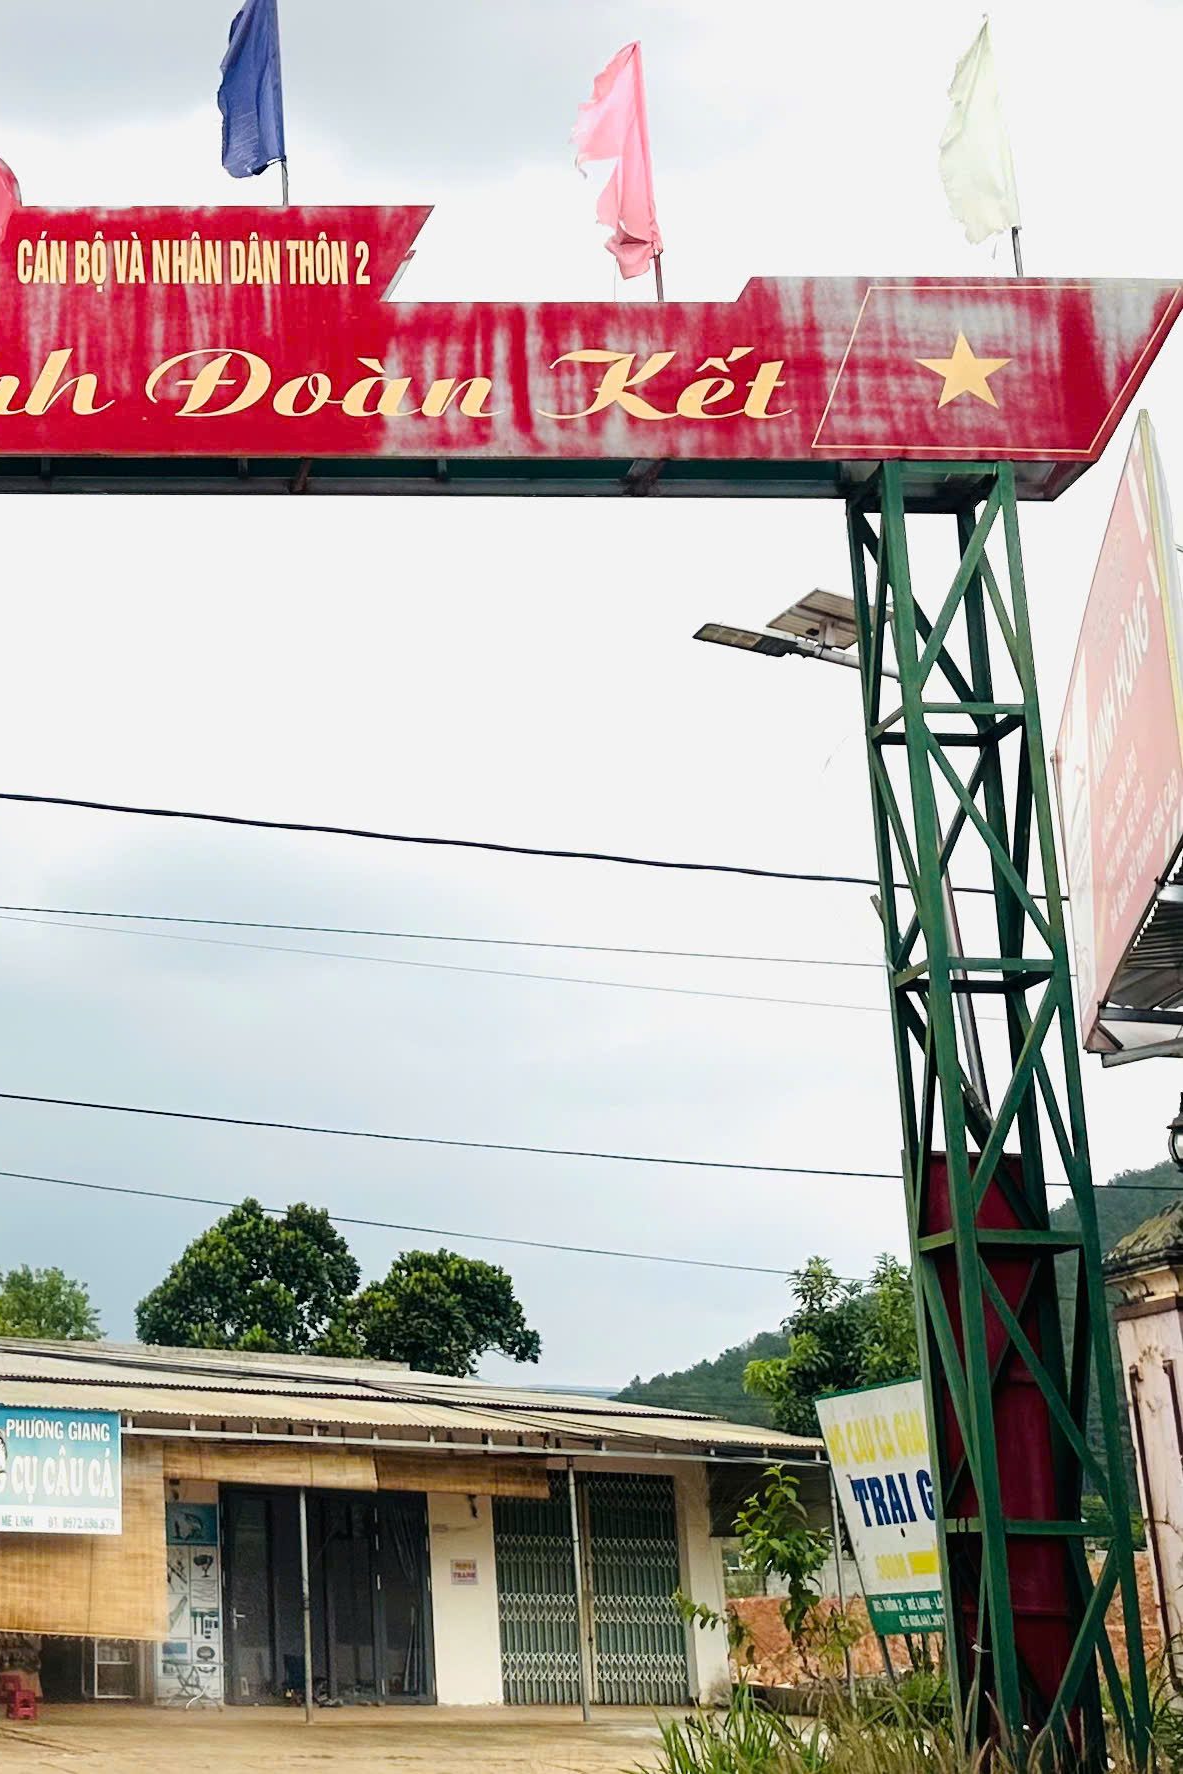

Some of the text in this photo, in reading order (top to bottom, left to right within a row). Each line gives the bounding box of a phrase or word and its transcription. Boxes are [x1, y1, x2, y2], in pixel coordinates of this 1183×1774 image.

[17, 231, 371, 293] CÁN BỘ VÀ NHÂN DÂN THÔN 2
[145, 347, 506, 418] Đoàn
[536, 346, 793, 420] Kết
[68, 1421, 111, 1442] GIANG
[10, 1455, 39, 1504] CỤ
[42, 1444, 84, 1497] CÂU
[87, 1447, 116, 1498] CÁ
